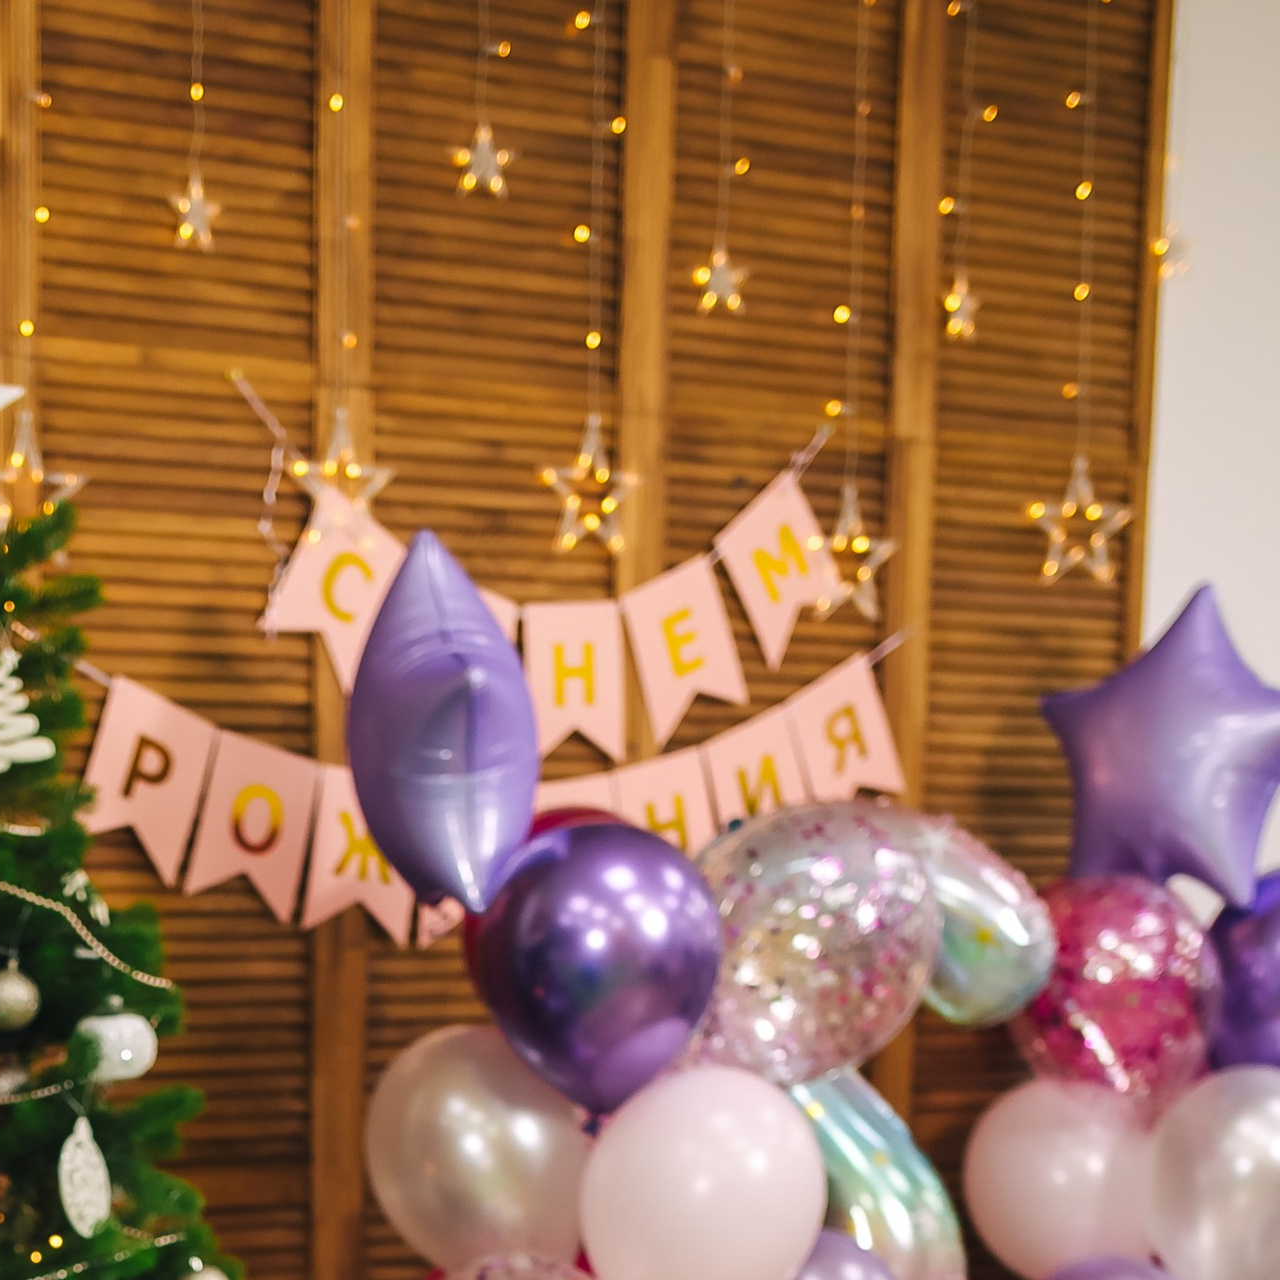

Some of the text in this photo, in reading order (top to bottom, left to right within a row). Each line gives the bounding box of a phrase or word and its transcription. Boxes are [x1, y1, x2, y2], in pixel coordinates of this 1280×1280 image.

[321, 523, 810, 708] С НЕМ
[123, 703, 869, 885] РОЖНИЯ
